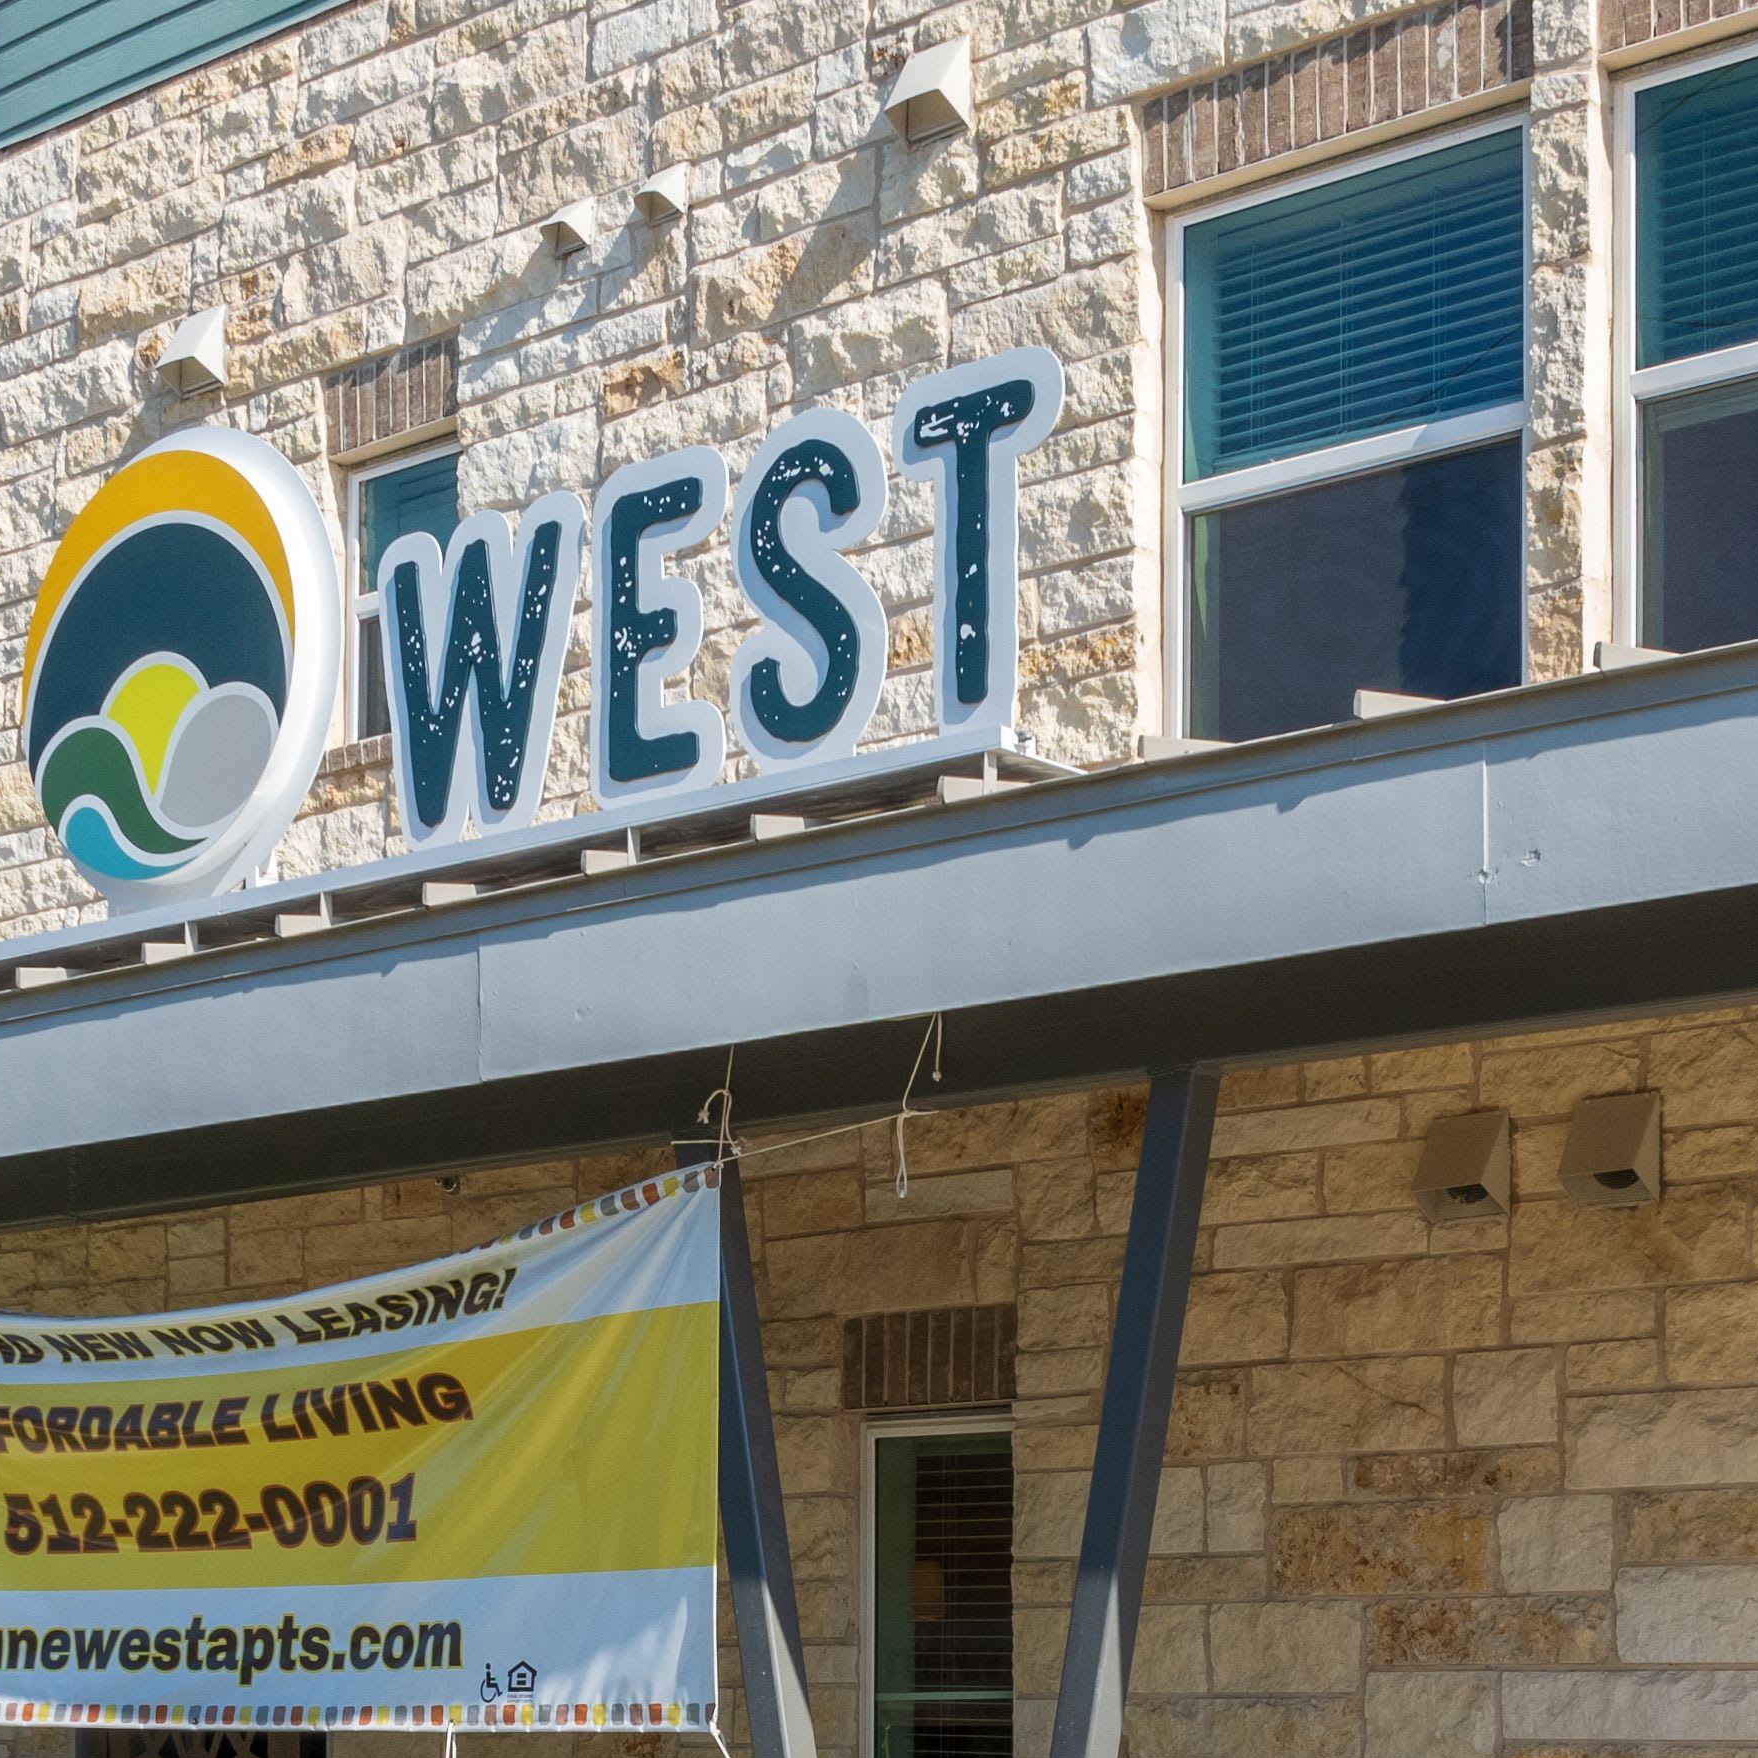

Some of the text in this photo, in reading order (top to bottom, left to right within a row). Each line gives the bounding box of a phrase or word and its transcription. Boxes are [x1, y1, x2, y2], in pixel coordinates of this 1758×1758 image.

[387, 377, 1037, 827] WEST
[46, 1328, 155, 1364] NEW
[155, 1318, 277, 1357] NOW
[277, 1267, 516, 1346] LEASING!
[262, 1372, 475, 1442] LIVING
[3, 1472, 419, 1556] 512-222-0001
